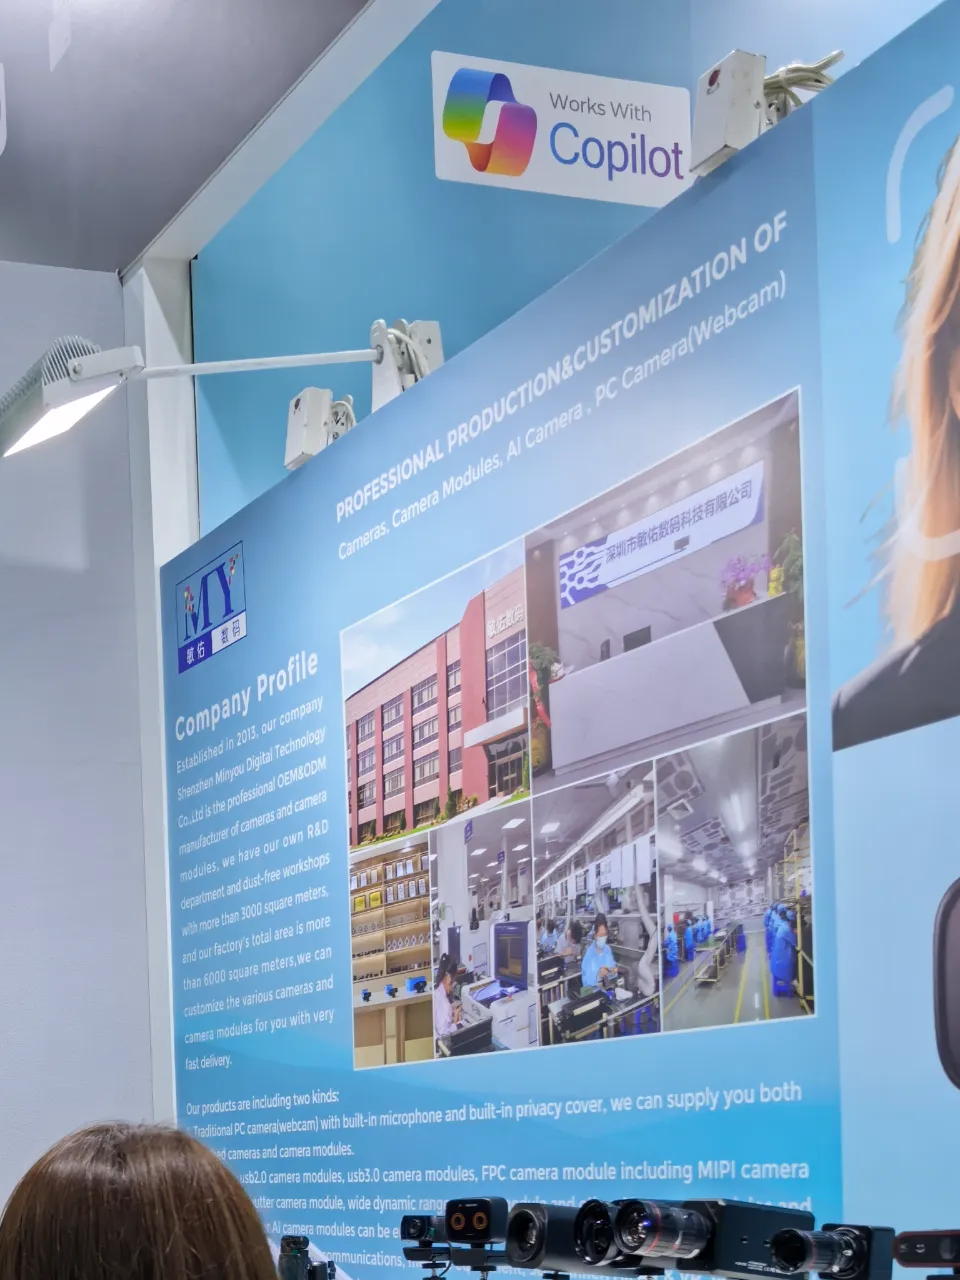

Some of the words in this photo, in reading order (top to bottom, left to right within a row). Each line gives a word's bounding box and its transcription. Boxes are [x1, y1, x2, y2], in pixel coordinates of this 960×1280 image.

[549, 92, 606, 117] Works
[610, 101, 652, 123] With
[549, 122, 685, 182] Copilot
[336, 439, 444, 523] PROFESSIONAL
[447, 238, 747, 453] PRODUCTION&CUSTOMIZATION
[753, 210, 788, 253] OF
[338, 521, 390, 560] Cameras,
[392, 489, 439, 528] Camera
[442, 453, 503, 499] Modules,
[506, 436, 521, 462] AI
[525, 401, 583, 449] Camera
[595, 376, 618, 407] PC
[621, 270, 787, 390] Camera(Webcam)
[605, 479, 753, 565] 深圳市敏佑数码科技有限公司
[175, 685, 251, 741] Company
[257, 650, 319, 702] Profile
[176, 740, 224, 774] Established
[226, 729, 234, 750] in
[236, 727, 259, 746] 2013,
[261, 718, 276, 735] our
[279, 696, 324, 726] company
[176, 778, 214, 801] Shenzhen
[215, 763, 245, 785] Minyou
[246, 747, 273, 772] Digital
[275, 727, 326, 759] Technology
[205, 805, 212, 819] is
[212, 800, 226, 814] the
[227, 776, 276, 812] professional
[277, 755, 327, 789] OEM&ODM
[178, 827, 229, 856] manufacturer
[230, 821, 240, 837] of
[240, 812, 275, 833] cameras
[277, 801, 293, 820] and
[294, 790, 328, 813] camera
[179, 859, 220, 883] modules,
[222, 855, 235, 869] we
[238, 846, 260, 864] have
[263, 837, 280, 855] our
[282, 829, 304, 848] own
[307, 819, 329, 839] R&D
[180, 884, 225, 910] department
[226, 878, 242, 895] and
[242, 867, 281, 891] dust-free
[282, 852, 331, 877] workshops
[181, 921, 198, 937] with
[199, 916, 220, 933] more
[221, 909, 239, 925] than
[241, 902, 262, 920] 3000
[264, 895, 293, 915] square
[294, 884, 329, 906] meters,
[182, 950, 197, 964] and
[199, 946, 212, 960] our
[214, 937, 250, 956] factory's
[252, 928, 272, 947] total
[274, 927, 294, 941] area
[295, 920, 303, 935] is
[305, 915, 331, 932] more
[183, 976, 202, 991] than
[203, 969, 226, 987] 6000
[228, 963, 259, 982] square
[314, 946, 332, 961] can
[183, 999, 225, 1018] customize
[226, 995, 240, 1010] the
[242, 989, 273, 1007] various
[275, 981, 314, 1000] cameras
[316, 974, 334, 991] and
[184, 1029, 215, 1044] camera
[216, 1022, 253, 1040] modules
[255, 1018, 268, 1032] for
[270, 1016, 287, 1033] you
[289, 1009, 311, 1027] with
[313, 1008, 335, 1024] very
[185, 1057, 200, 1071] fast
[200, 1054, 232, 1069] delivery.
[186, 1102, 201, 1116] Our
[202, 1099, 236, 1117] products
[237, 1099, 251, 1111] are
[252, 1092, 291, 1111] including
[293, 1091, 311, 1106] two
[311, 1087, 340, 1104] kinds:
[193, 1122, 233, 1139] Traditional
[234, 1122, 246, 1136] PC
[247, 1116, 319, 1135] camera(webcam)
[320, 1114, 340, 1130] with
[343, 1111, 377, 1129] built-in
[379, 1108, 443, 1128] microphone
[445, 1104, 467, 1122] and
[469, 1101, 513, 1121] built-in
[516, 1099, 562, 1122] privacy
[565, 1097, 607, 1115] cover,
[610, 1096, 632, 1112] we
[636, 1093, 663, 1110] can
[667, 1086, 719, 1112] supply
[722, 1088, 755, 1110] you
[759, 1080, 803, 1103] both
[227, 1149, 261, 1161] cameras
[262, 1144, 278, 1159] and
[279, 1145, 311, 1158] camera
[312, 1140, 355, 1156] modules.
[240, 1170, 267, 1184] usb2.0
[268, 1171, 301, 1184] camera
[302, 1168, 345, 1184] modules,
[347, 1167, 380, 1183] usb3.0
[382, 1169, 422, 1182] camera
[424, 1165, 478, 1183] modules,
[481, 1164, 507, 1181] FPC
[509, 1166, 559, 1181] camera
[562, 1161, 617, 1180] module
[620, 1160, 693, 1184] including
[697, 1159, 736, 1179] MIPI
[740, 1161, 810, 1179] camera
[271, 1221, 281, 1234] AI
[282, 1224, 314, 1235] camera
[316, 1221, 355, 1237] modules
[357, 1225, 376, 1238] can
[377, 1222, 391, 1239] be
[275, 1197, 307, 1209] camera
[309, 1195, 346, 1211] module,
[347, 1195, 372, 1210] wide
[373, 1194, 416, 1214] dynamic
